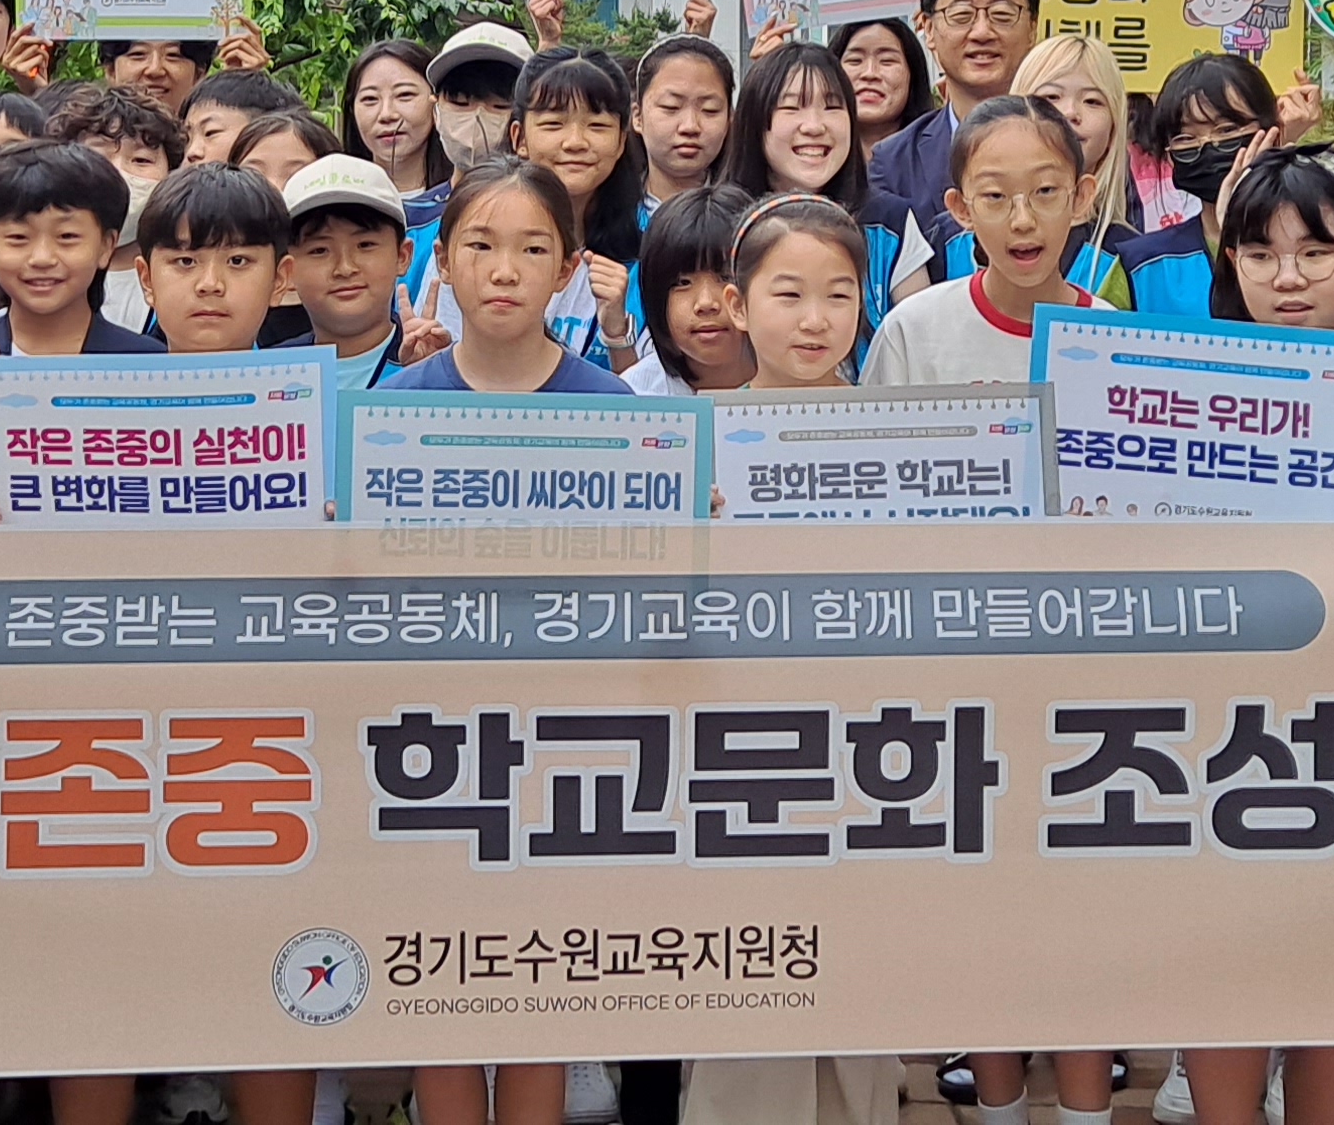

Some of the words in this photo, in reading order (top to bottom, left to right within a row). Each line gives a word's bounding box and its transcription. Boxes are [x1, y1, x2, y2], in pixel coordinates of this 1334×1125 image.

[1107, 383, 1200, 430] 학교는
[1208, 393, 1311, 439] 우리가!
[6, 427, 73, 466] 작은
[82, 427, 182, 467] 존중의
[193, 422, 306, 465] 실천이!
[1056, 427, 1178, 475] 존중으로
[1187, 439, 1279, 485] 만드는
[8, 474, 43, 512] 큰
[51, 474, 150, 514] 변화를
[160, 472, 308, 514] 만들어요!
[365, 467, 424, 508] 작은
[432, 468, 520, 509] 존중이
[527, 469, 615, 511] 씨앗이
[623, 471, 682, 512] 되어
[748, 459, 888, 503] 평화로운
[895, 457, 1012, 498] 학교는!
[4, 595, 217, 648] 존중받는
[234, 592, 515, 649] 교육공동체,
[533, 588, 790, 643] 경기교육이
[811, 587, 913, 641] 함께
[931, 585, 1244, 639] 만들어갑니다
[366, 705, 1000, 863] 학교문화
[382, 923, 819, 986] 경기도수원교육지원청
[386, 996, 520, 1016] GYEONGGIDO
[524, 995, 597, 1013] SUWON
[601, 994, 670, 1012] OFFICE
[674, 993, 701, 1010] OF
[705, 991, 816, 1009] EDUCATION
